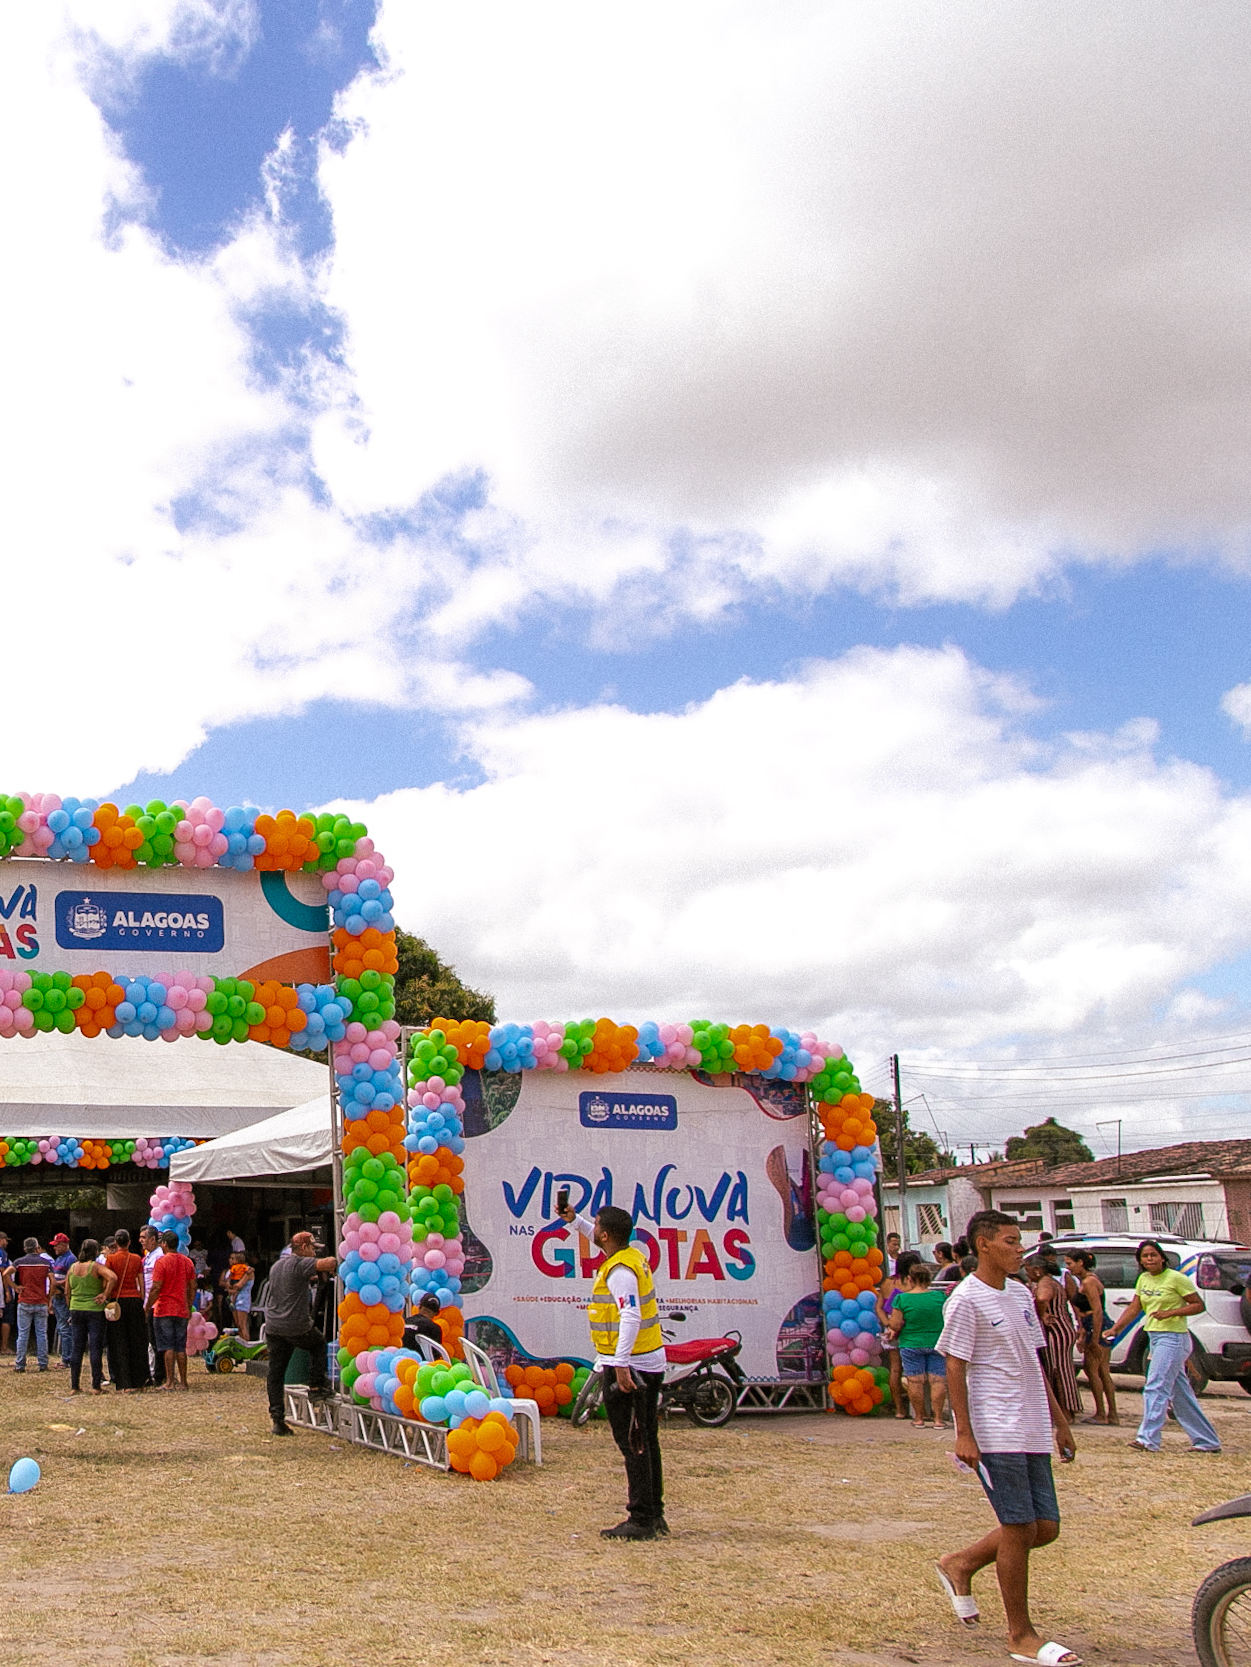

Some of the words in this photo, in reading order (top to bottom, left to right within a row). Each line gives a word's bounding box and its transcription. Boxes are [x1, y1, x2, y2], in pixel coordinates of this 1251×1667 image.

[112, 911, 210, 930] ALAGOAS
[118, 928, 205, 938] GOVERNO
[612, 1103, 670, 1116] ALAGOAS
[502, 1166, 613, 1232] VIDA
[632, 1164, 749, 1227] NOVA
[509, 1225, 535, 1236] NAS
